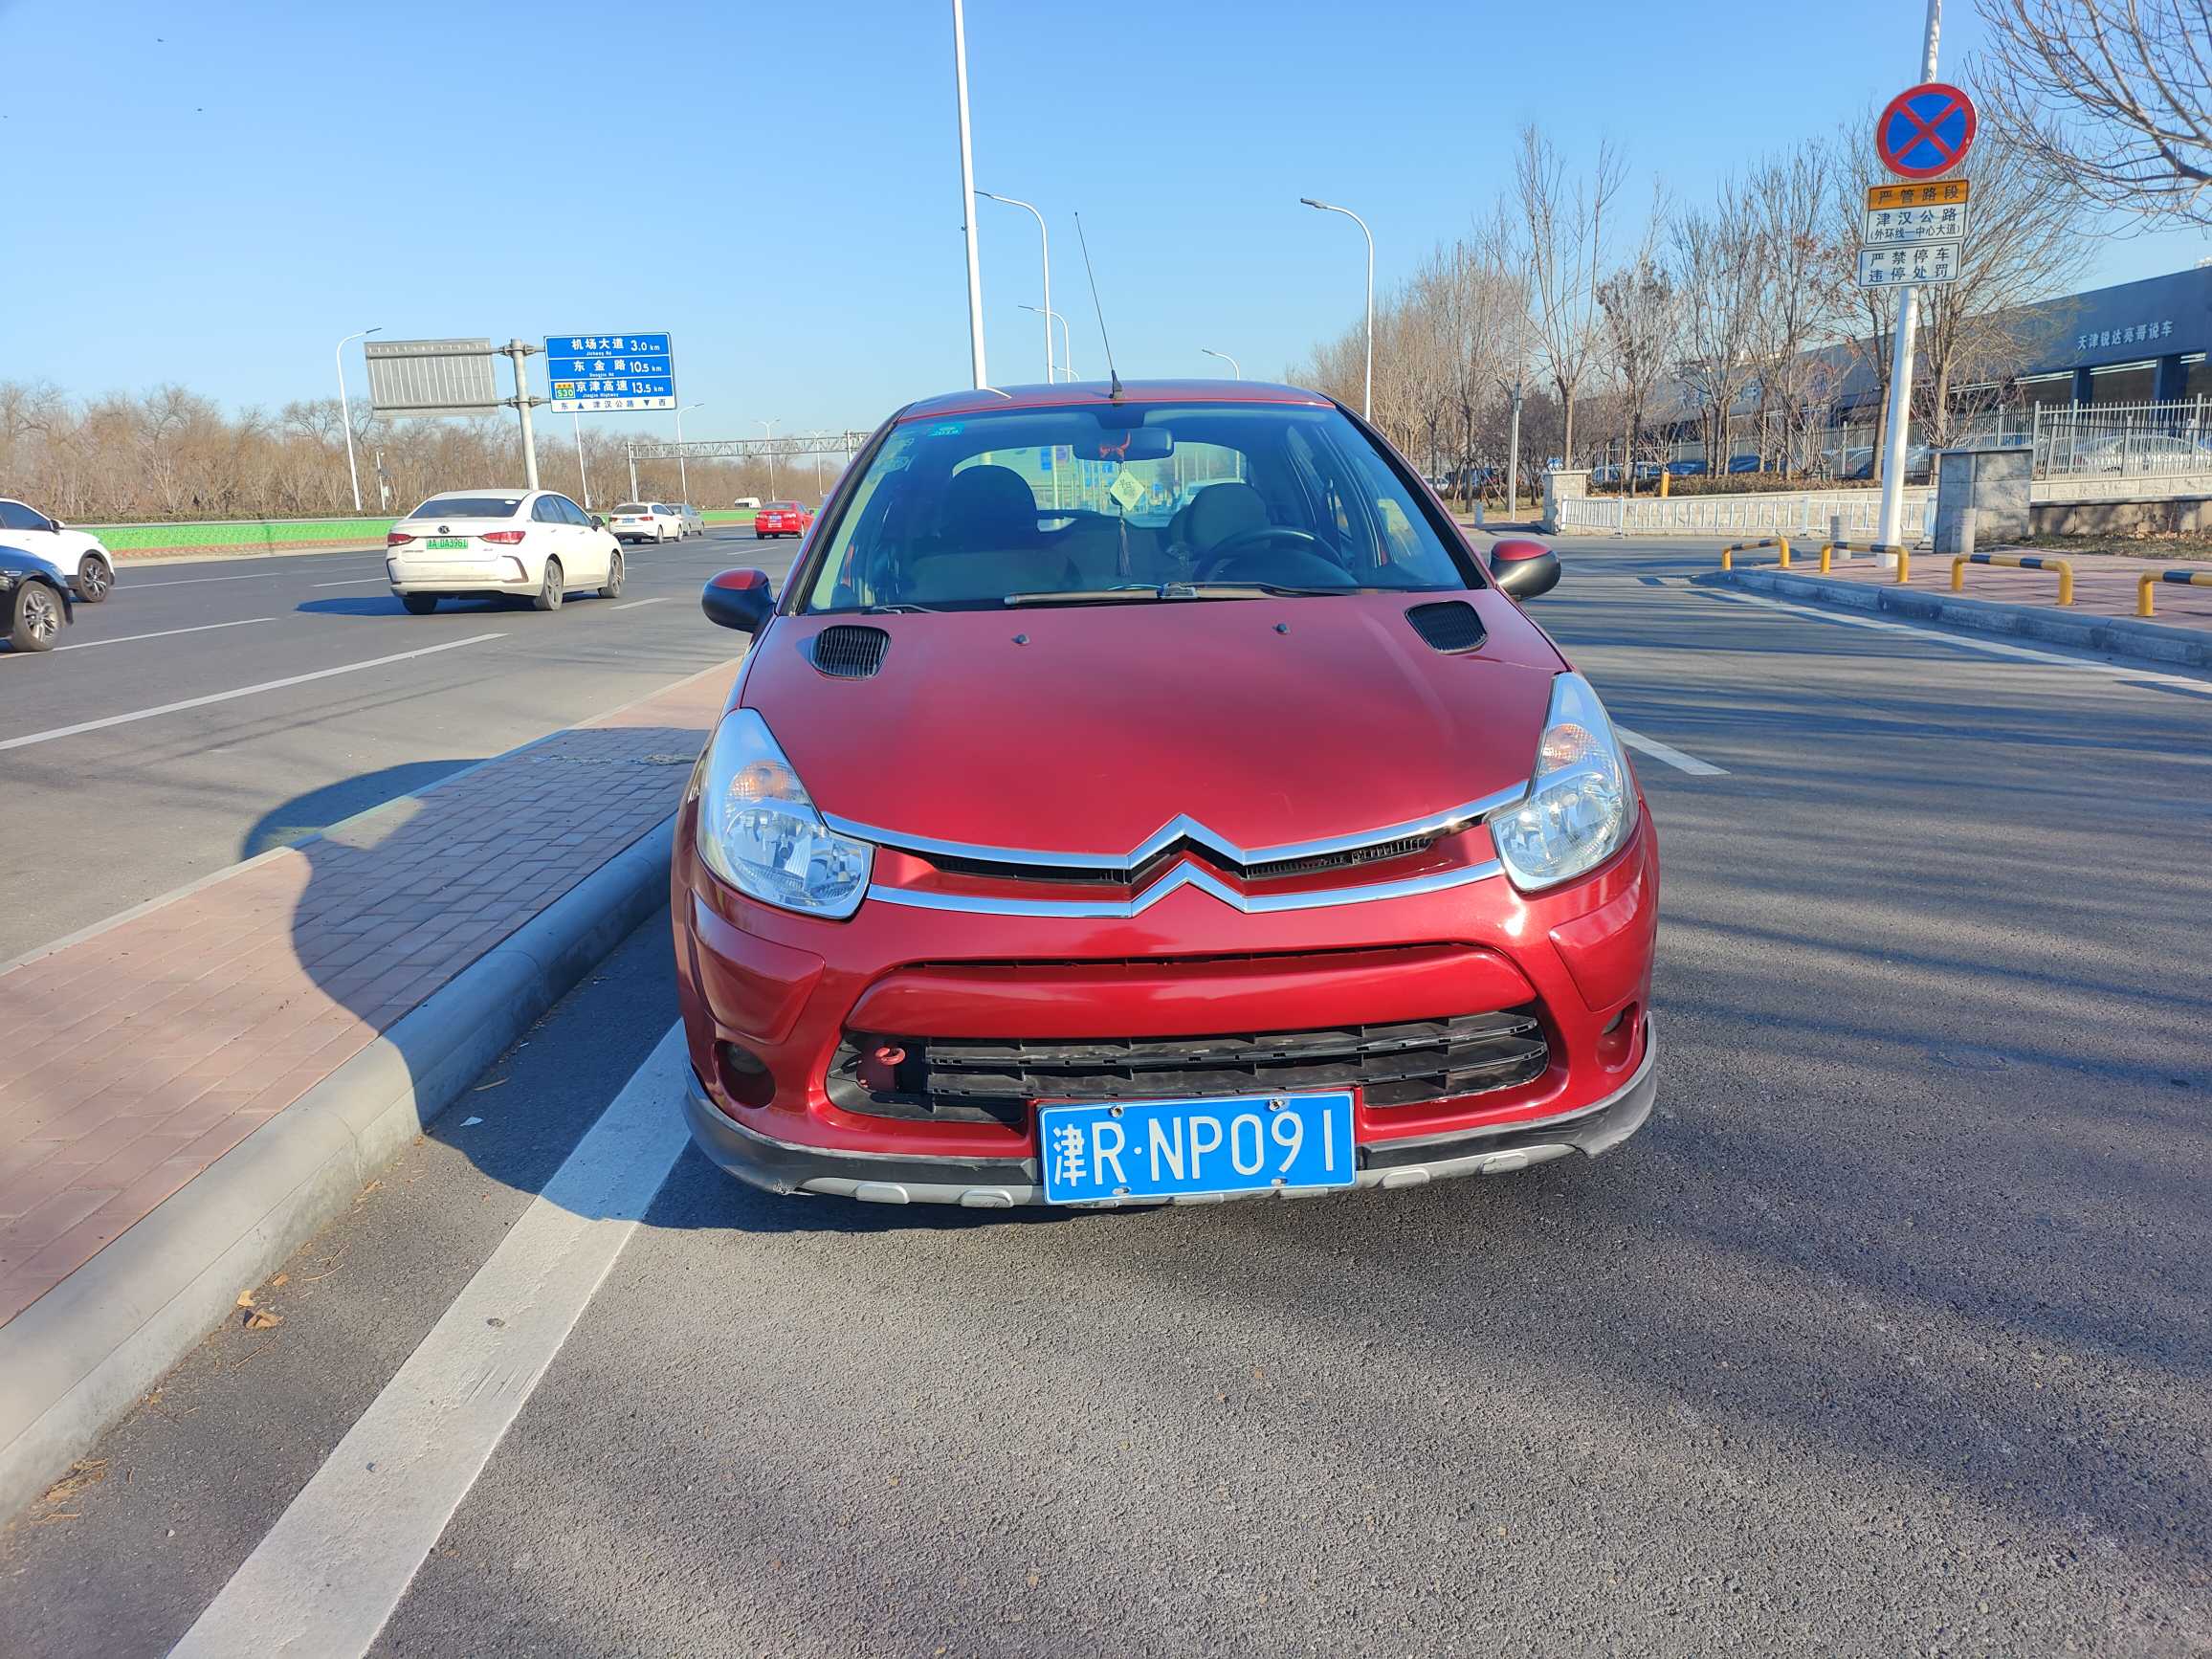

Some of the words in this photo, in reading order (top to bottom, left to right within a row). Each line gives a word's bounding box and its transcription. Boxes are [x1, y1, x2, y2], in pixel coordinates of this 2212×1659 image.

[1877, 185, 1959, 205] 严管路段
[1876, 208, 1958, 227] 津汉公路
[1869, 247, 1950, 267] 严禁停车
[1869, 263, 1948, 282] 违停处罚
[571, 338, 625, 351] 机场大道
[630, 340, 648, 352] 3.0
[574, 359, 627, 372] 东金路
[630, 361, 650, 373] 10.5
[557, 388, 574, 397] S30
[575, 380, 629, 393] 京津高速
[631, 382, 652, 394] 13.5
[593, 399, 634, 409] 津汉公路
[1052, 1109, 1335, 1188] 津R·NP091
